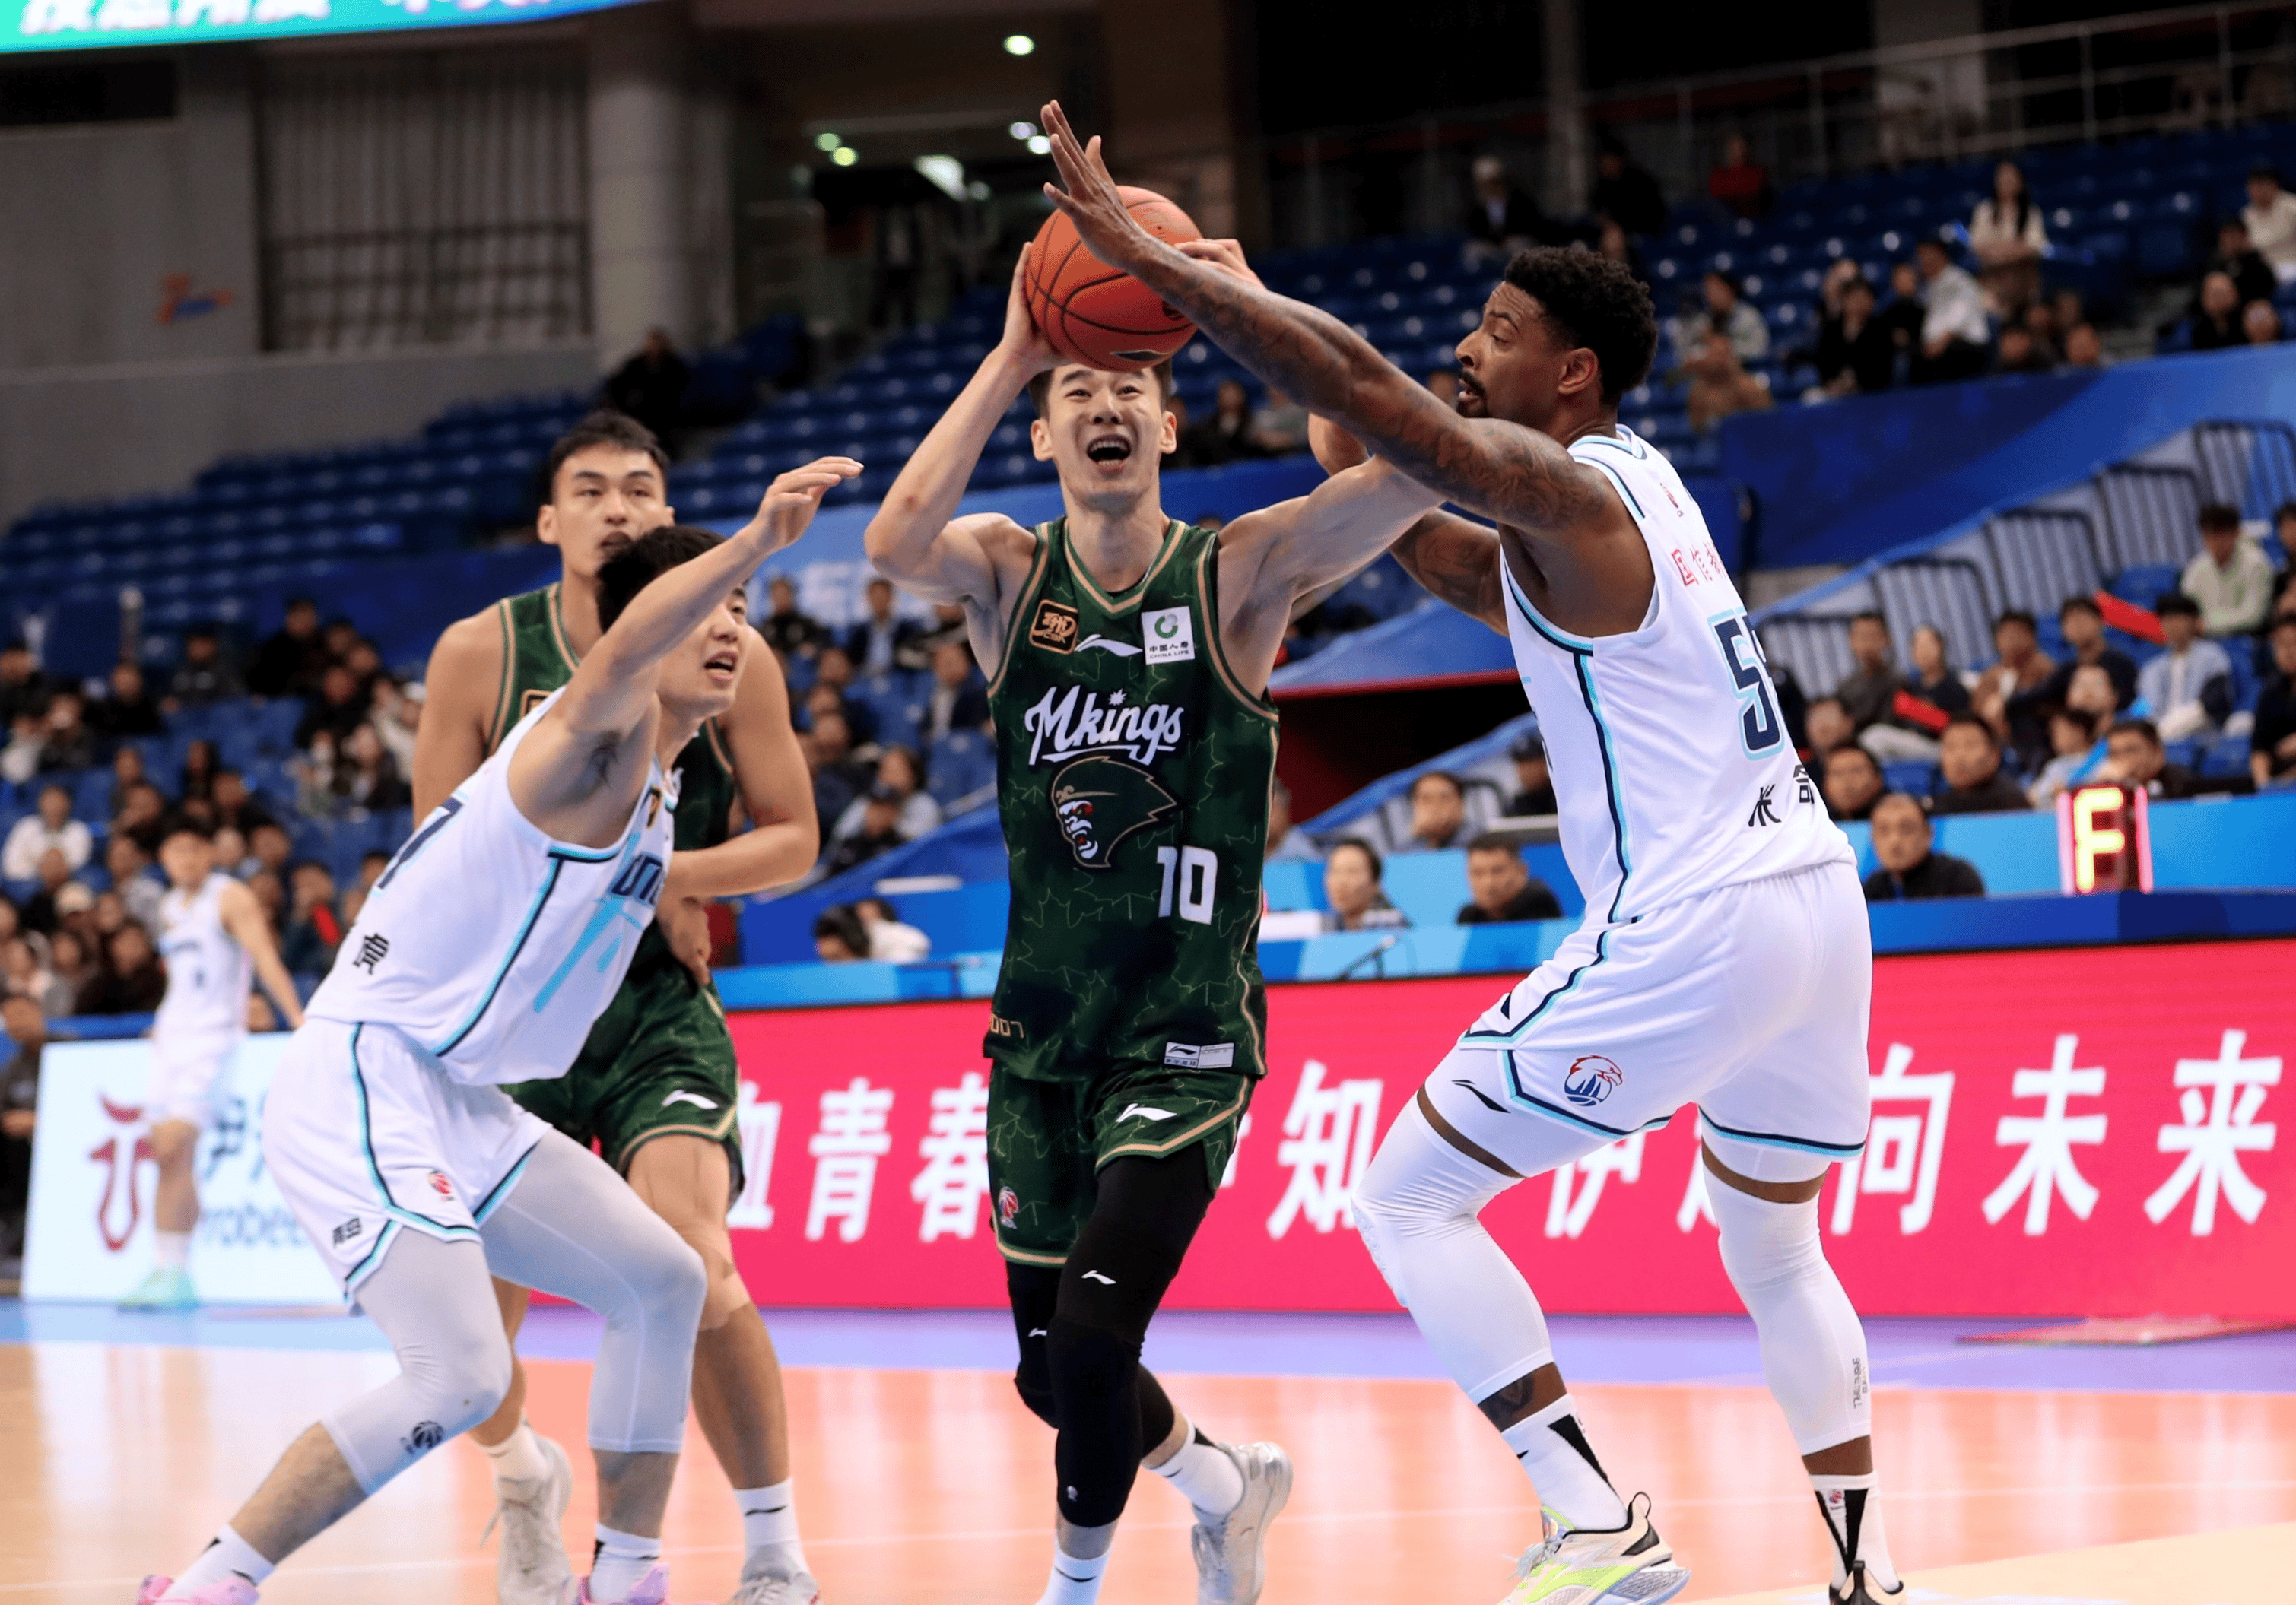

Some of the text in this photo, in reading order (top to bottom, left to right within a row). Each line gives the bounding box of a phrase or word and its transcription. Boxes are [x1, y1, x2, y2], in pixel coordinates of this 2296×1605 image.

[1024, 684, 1184, 766] Mkings
[1707, 607, 1783, 761] 5
[1156, 845, 1218, 925] 10
[2073, 786, 2126, 894] F
